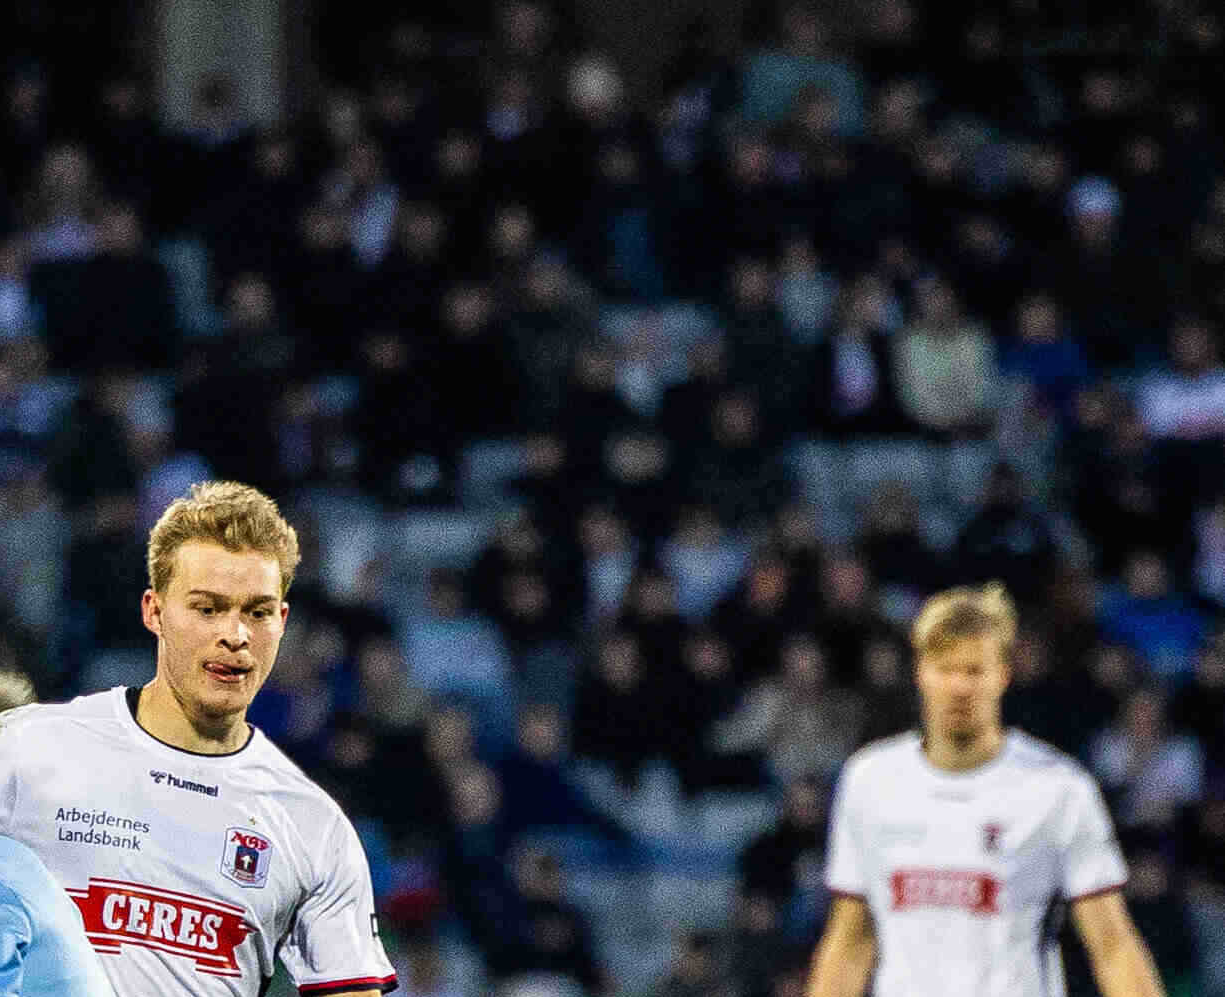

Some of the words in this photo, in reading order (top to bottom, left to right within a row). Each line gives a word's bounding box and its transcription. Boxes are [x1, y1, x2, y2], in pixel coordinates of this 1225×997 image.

[167, 773, 219, 797] hummel
[55, 807, 151, 834] Arbejdernes
[58, 827, 142, 851] Landsbank
[102, 893, 224, 951] CERES
